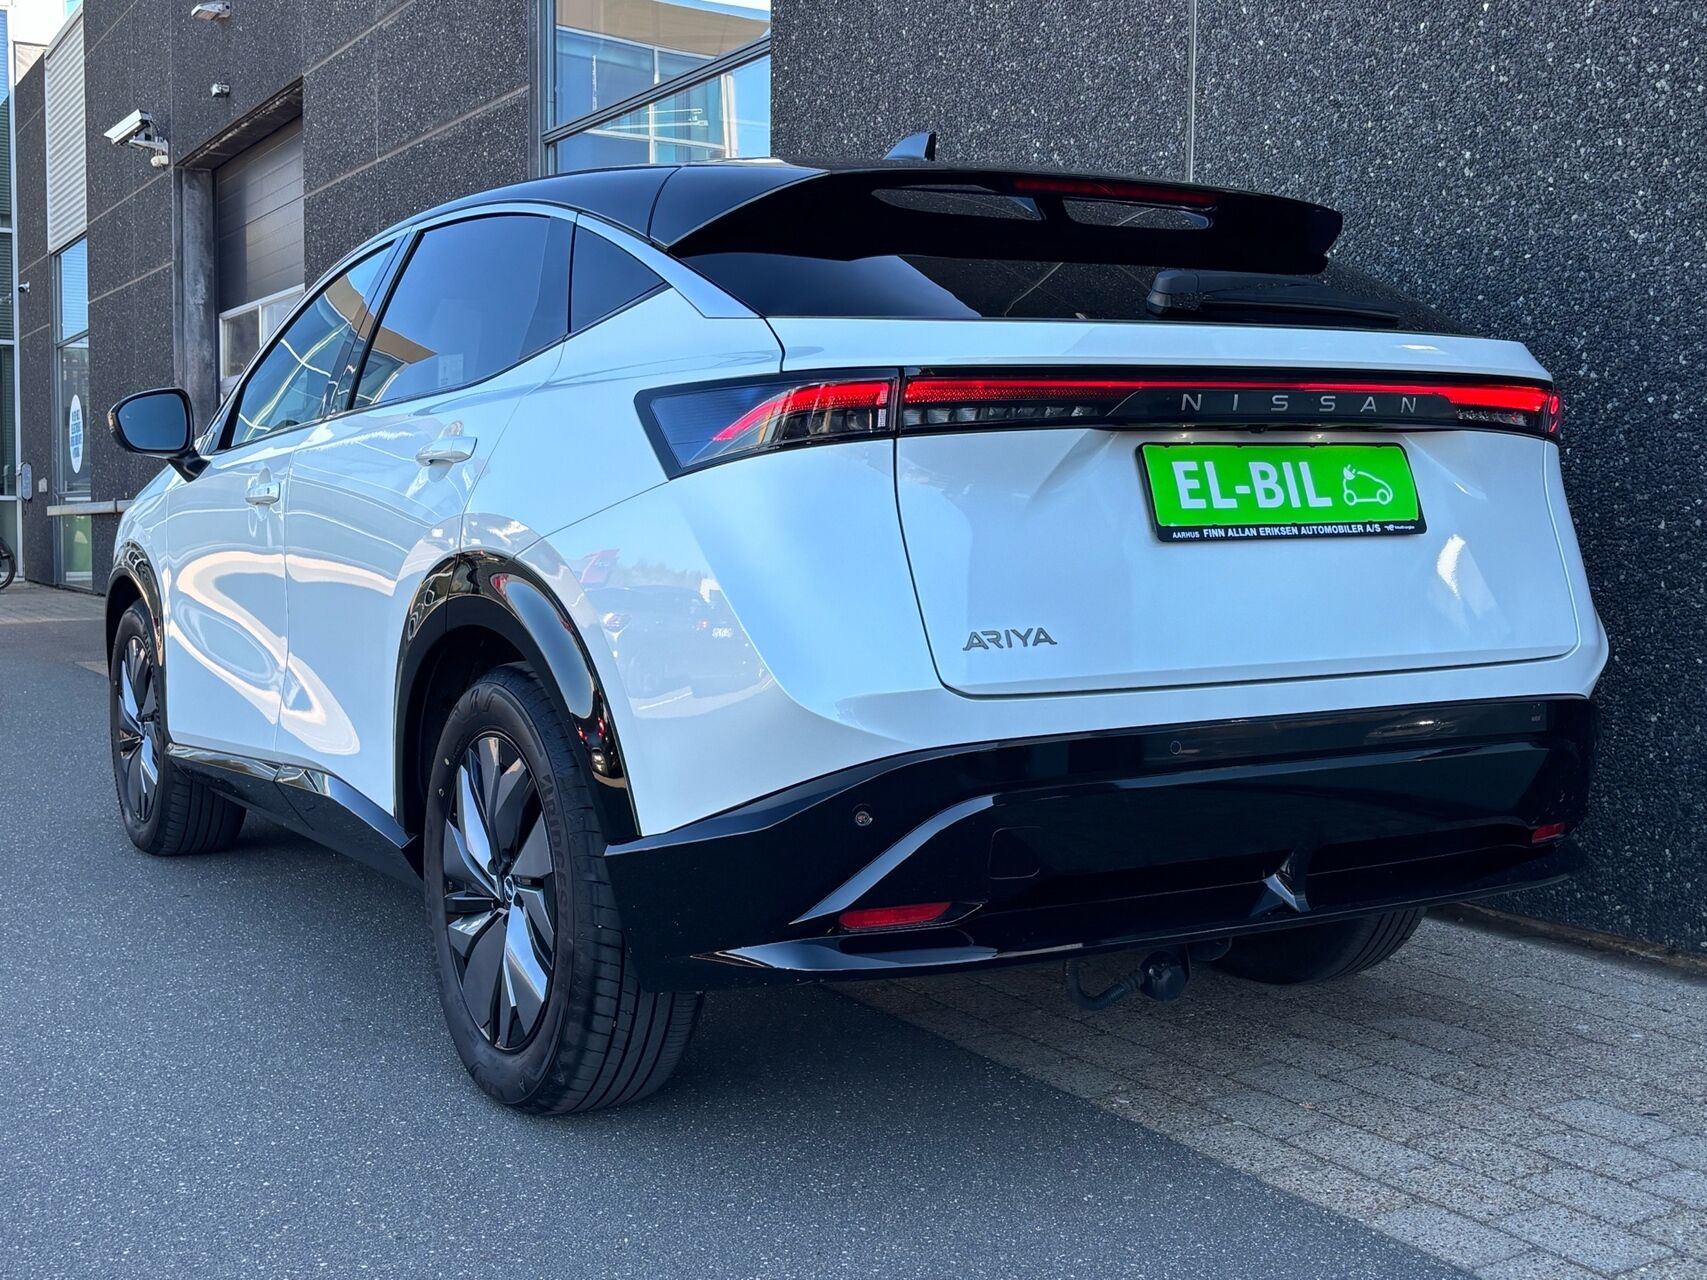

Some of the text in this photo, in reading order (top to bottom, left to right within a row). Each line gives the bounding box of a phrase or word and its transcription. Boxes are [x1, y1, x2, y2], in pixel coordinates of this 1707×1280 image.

[1180, 393, 1417, 414] NISSAN
[1171, 460, 1333, 509] EL-BIL
[1172, 531, 1200, 539] AARHUS
[1203, 528, 1226, 538] FINN
[1227, 527, 1258, 537] ALLAN
[1259, 526, 1299, 537] ERIKSEN
[1300, 524, 1364, 535] AUTOMOBILER
[1366, 524, 1381, 533] A/S
[962, 626, 1058, 652] ARIYA
[540, 774, 571, 975] BRIDGEST
